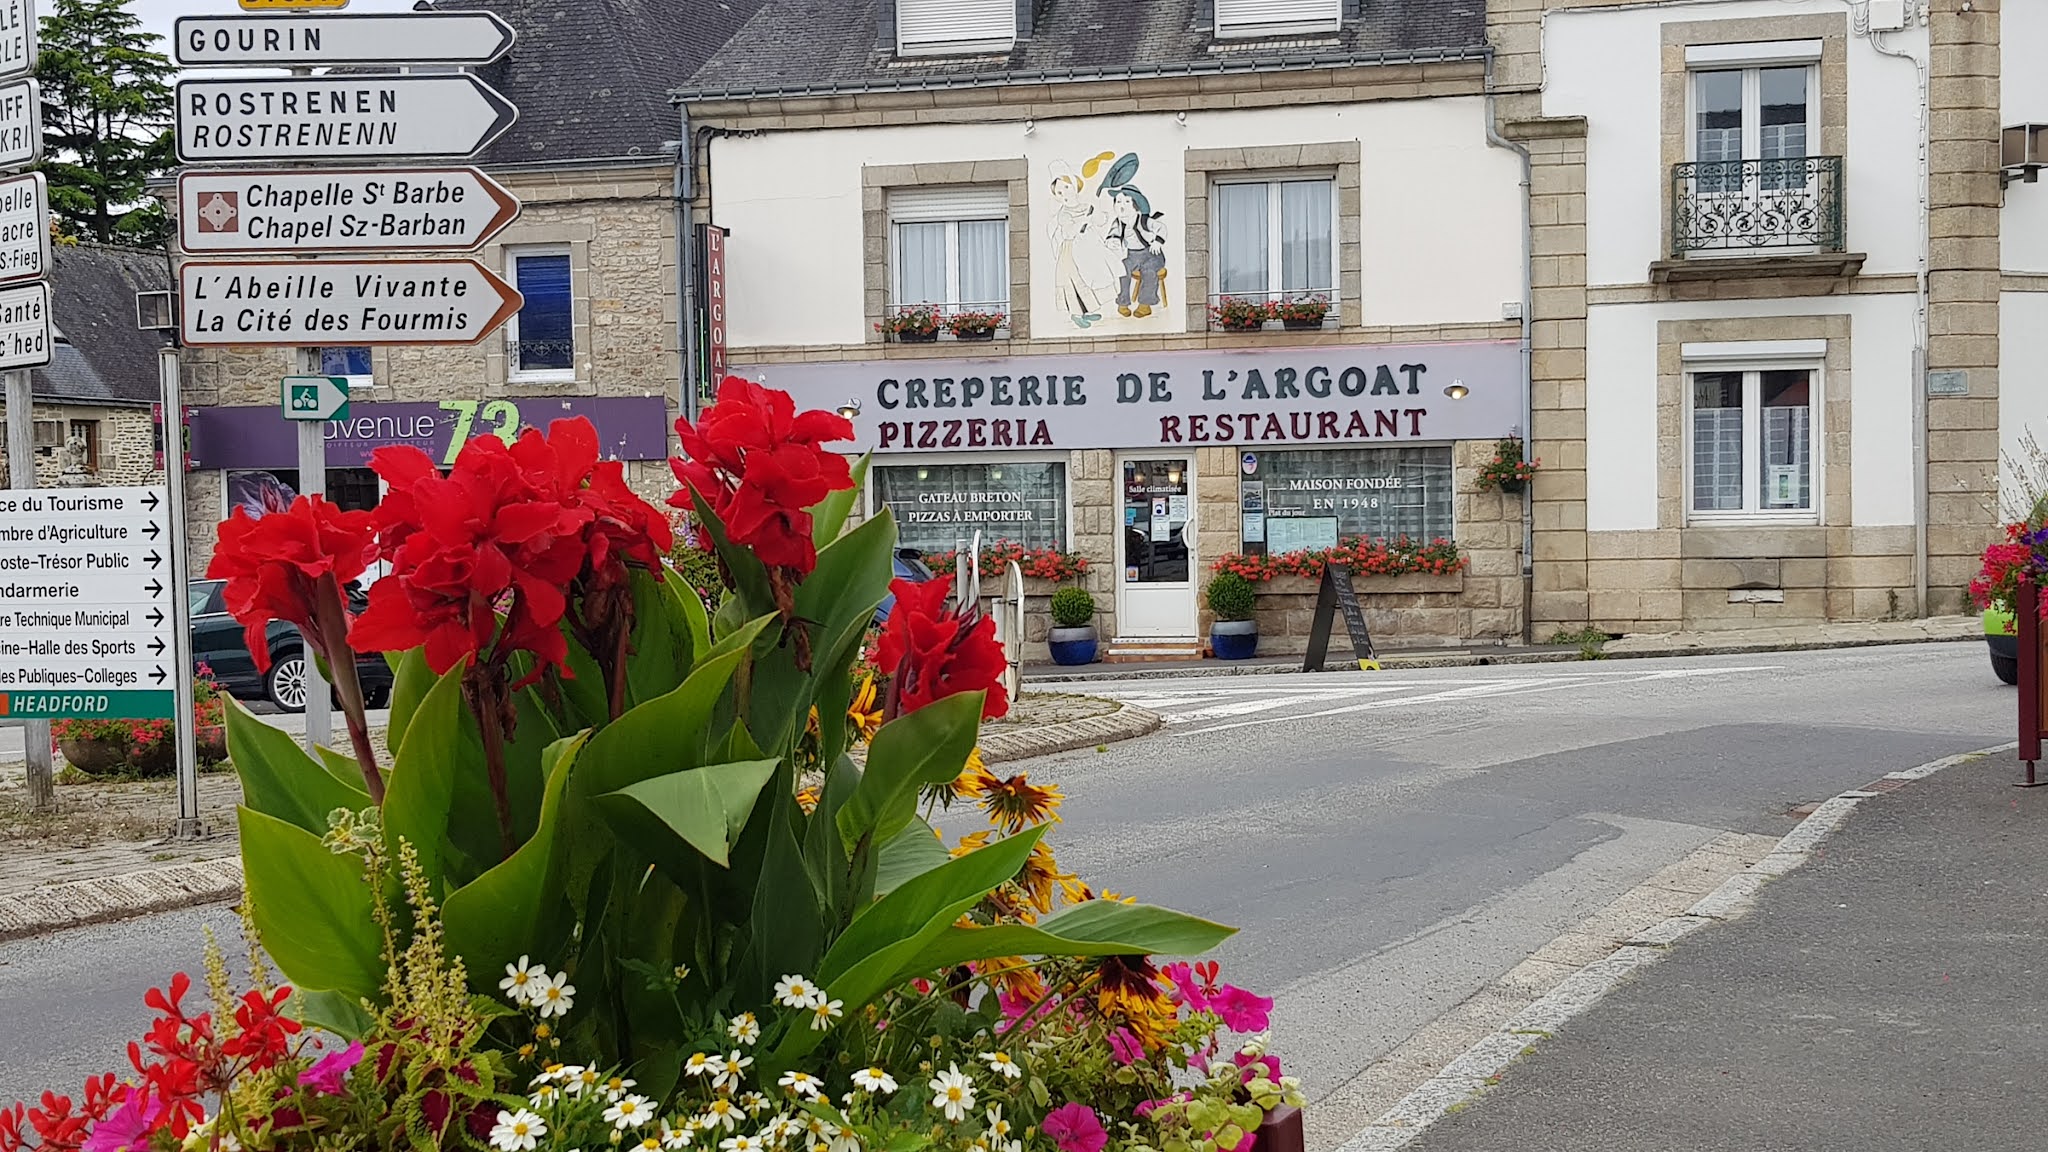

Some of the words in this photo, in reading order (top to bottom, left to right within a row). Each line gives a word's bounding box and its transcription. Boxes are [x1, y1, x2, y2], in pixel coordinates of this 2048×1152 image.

[0, 36, 22, 65] LE
[189, 28, 321, 52] GOURIN
[191, 89, 397, 116] ROSTRENEN
[193, 121, 398, 148] ROSTRENENN
[0, 186, 32, 214] elle
[246, 183, 354, 213] Chapelle
[362, 182, 385, 205] St
[393, 180, 465, 204] Barbe
[247, 214, 333, 244] Chapel
[340, 213, 466, 238] Sz-Barban
[195, 275, 334, 300] L'Abeille
[355, 274, 468, 298] Vivante
[0, 297, 40, 324] anté
[195, 308, 224, 332] La
[237, 308, 292, 332] Cité
[304, 308, 349, 331] des
[361, 306, 468, 331] Fourmis
[876, 375, 1087, 409] CREPERIE
[1116, 372, 1172, 404] DE
[1202, 363, 1427, 401] L'ARGOAT
[324, 416, 435, 440] avenue
[878, 418, 1054, 449] PIZZERIA
[1160, 408, 1427, 443] RESTAURANT
[1289, 478, 1343, 491] MAISON
[1346, 475, 1403, 490] FONDÉE
[22, 496, 42, 512] du
[48, 495, 124, 511] Tourisme
[918, 493, 967, 504] GATEAU
[970, 491, 1021, 503] BRETON
[1313, 498, 1334, 510] EN
[1342, 497, 1379, 509] 1948
[908, 511, 950, 523] PIZZAS
[953, 509, 962, 522] À
[964, 510, 1033, 522] EMPORTER
[38, 524, 128, 544] d'Agriculture
[87, 553, 129, 569] Public
[14, 611, 72, 630] Technique
[75, 610, 129, 629] Municipal
[64, 640, 88, 655] des
[92, 639, 136, 658] Sports
[19, 667, 138, 687] Publiques-Colleges
[13, 695, 109, 713] HEADFORD
